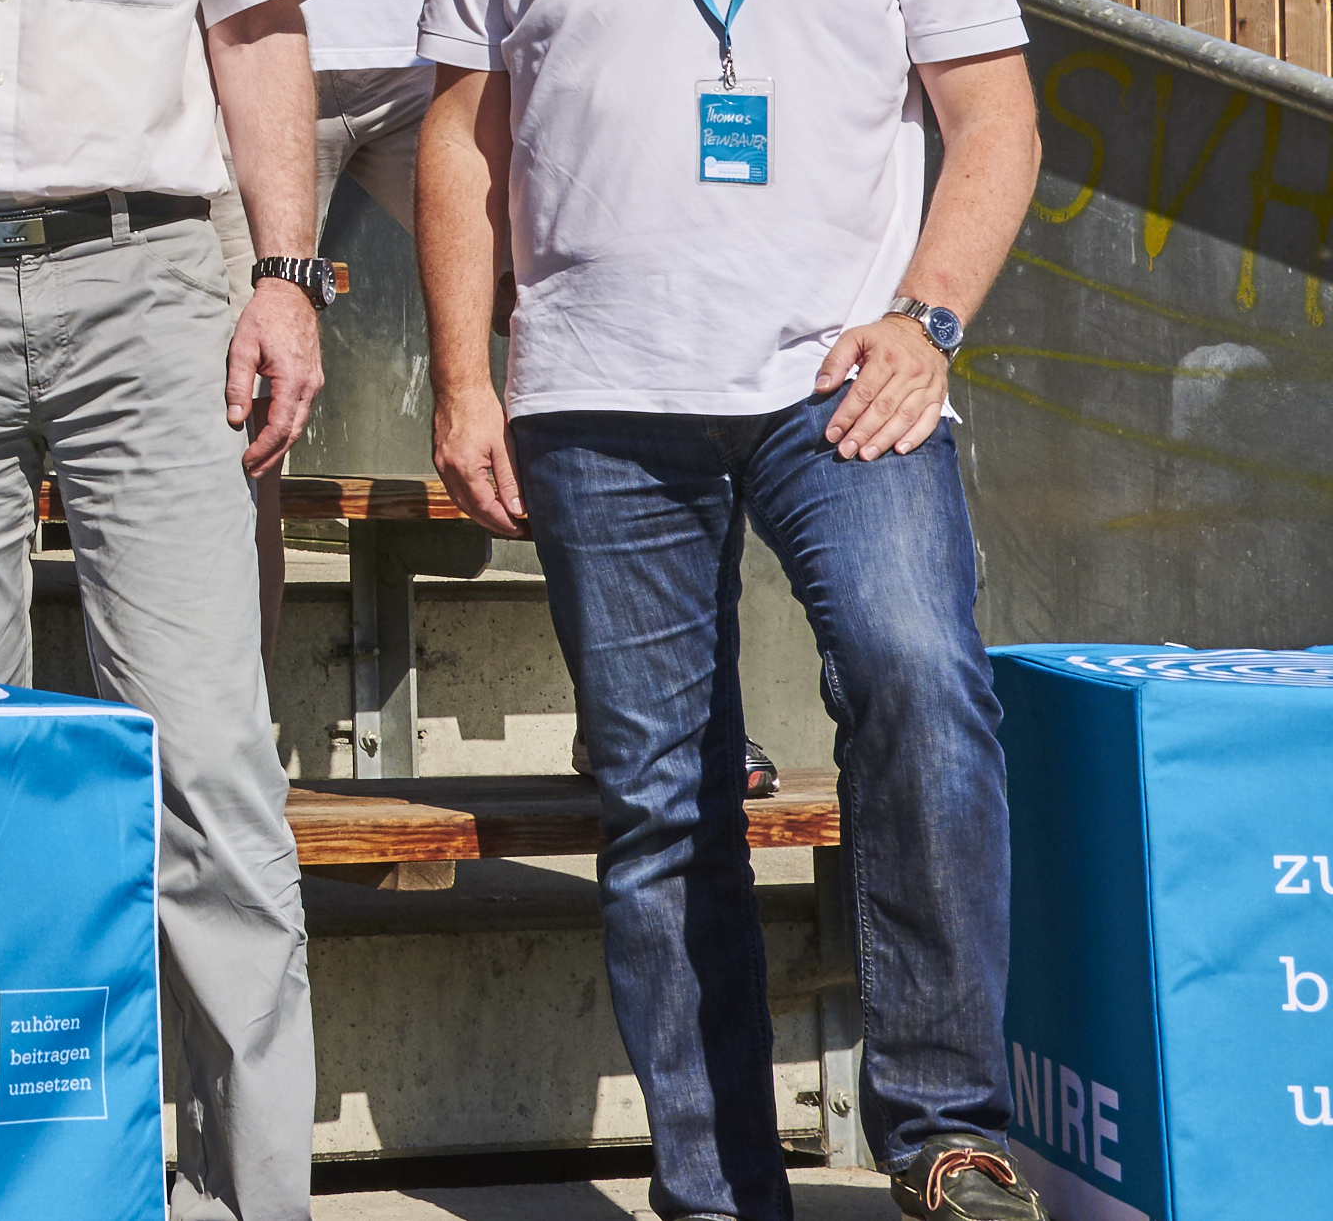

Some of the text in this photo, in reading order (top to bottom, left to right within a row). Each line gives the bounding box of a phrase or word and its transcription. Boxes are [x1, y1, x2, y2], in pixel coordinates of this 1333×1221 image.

[704, 103, 752, 125] Thomas
[10, 1014, 82, 1035] zuhören
[9, 1045, 91, 1070] beitragen
[8, 1075, 92, 1096] umsetzen
